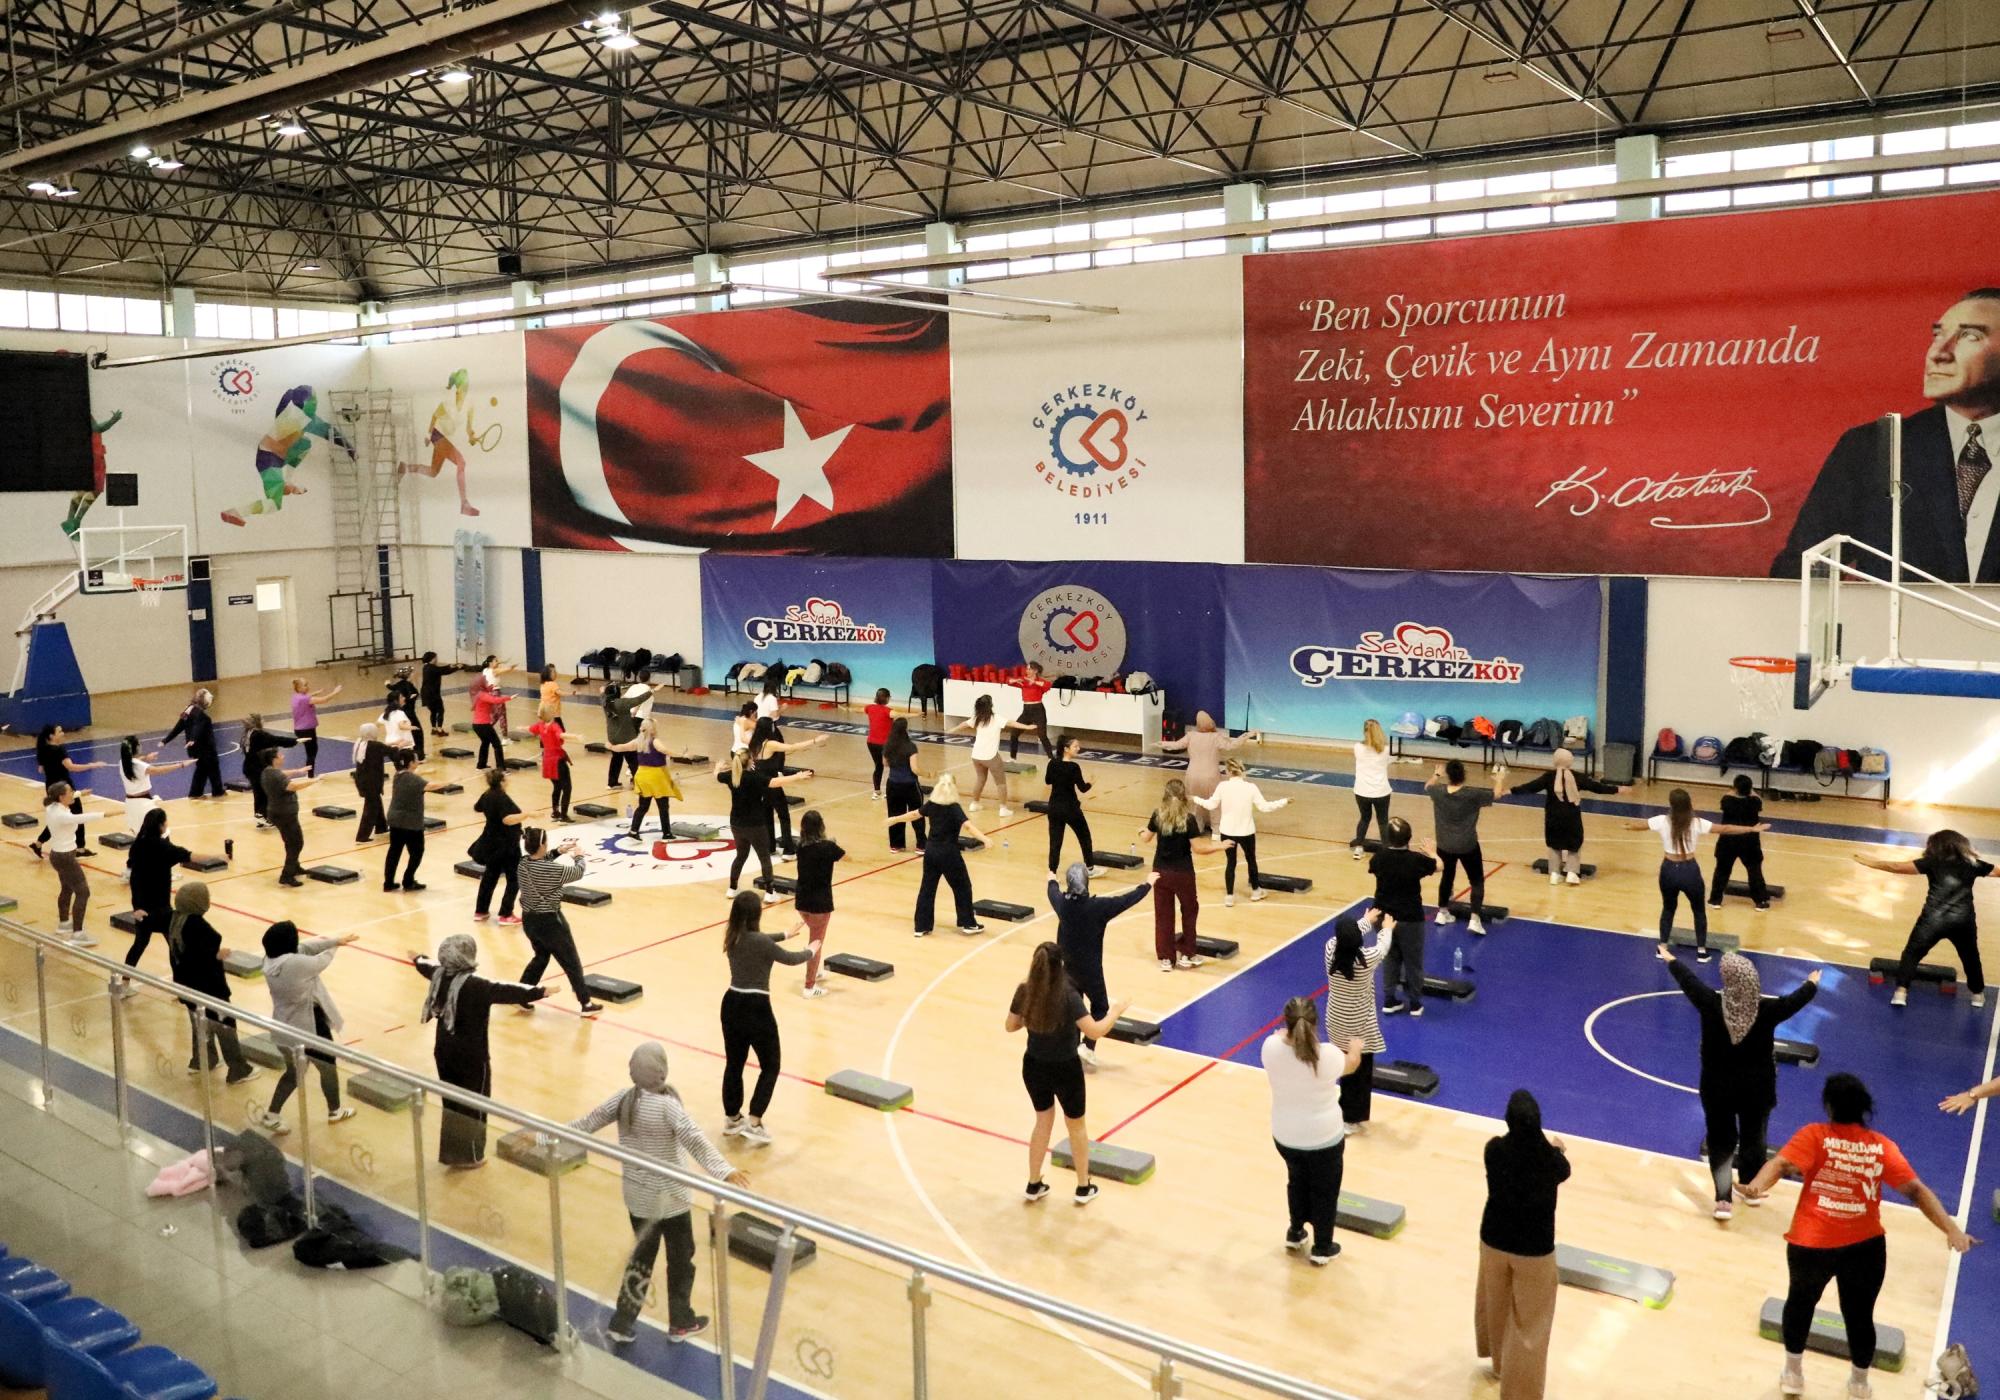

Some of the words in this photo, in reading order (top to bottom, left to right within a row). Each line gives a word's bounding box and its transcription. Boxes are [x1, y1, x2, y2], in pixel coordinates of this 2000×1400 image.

[1381, 293, 1566, 337] Sporcunun
[1294, 348, 1371, 385] Zeki,
[1385, 341, 1476, 387] Çevik
[1487, 349, 1522, 375] ve
[1530, 337, 1613, 383] Aynı
[1625, 325, 1821, 369] Zamanda
[1032, 384, 1148, 429] ÇERKEZKÖY
[1290, 397, 1463, 432] Ahlaklısını
[1035, 458, 1146, 498] BELEDİYESİ
[1074, 512, 1108, 524] 1911
[747, 619, 884, 647] ÇERKEZKÖY
[1360, 634, 1468, 660] Sevdamız
[1293, 649, 1521, 684] ÇERKEZKÖY
